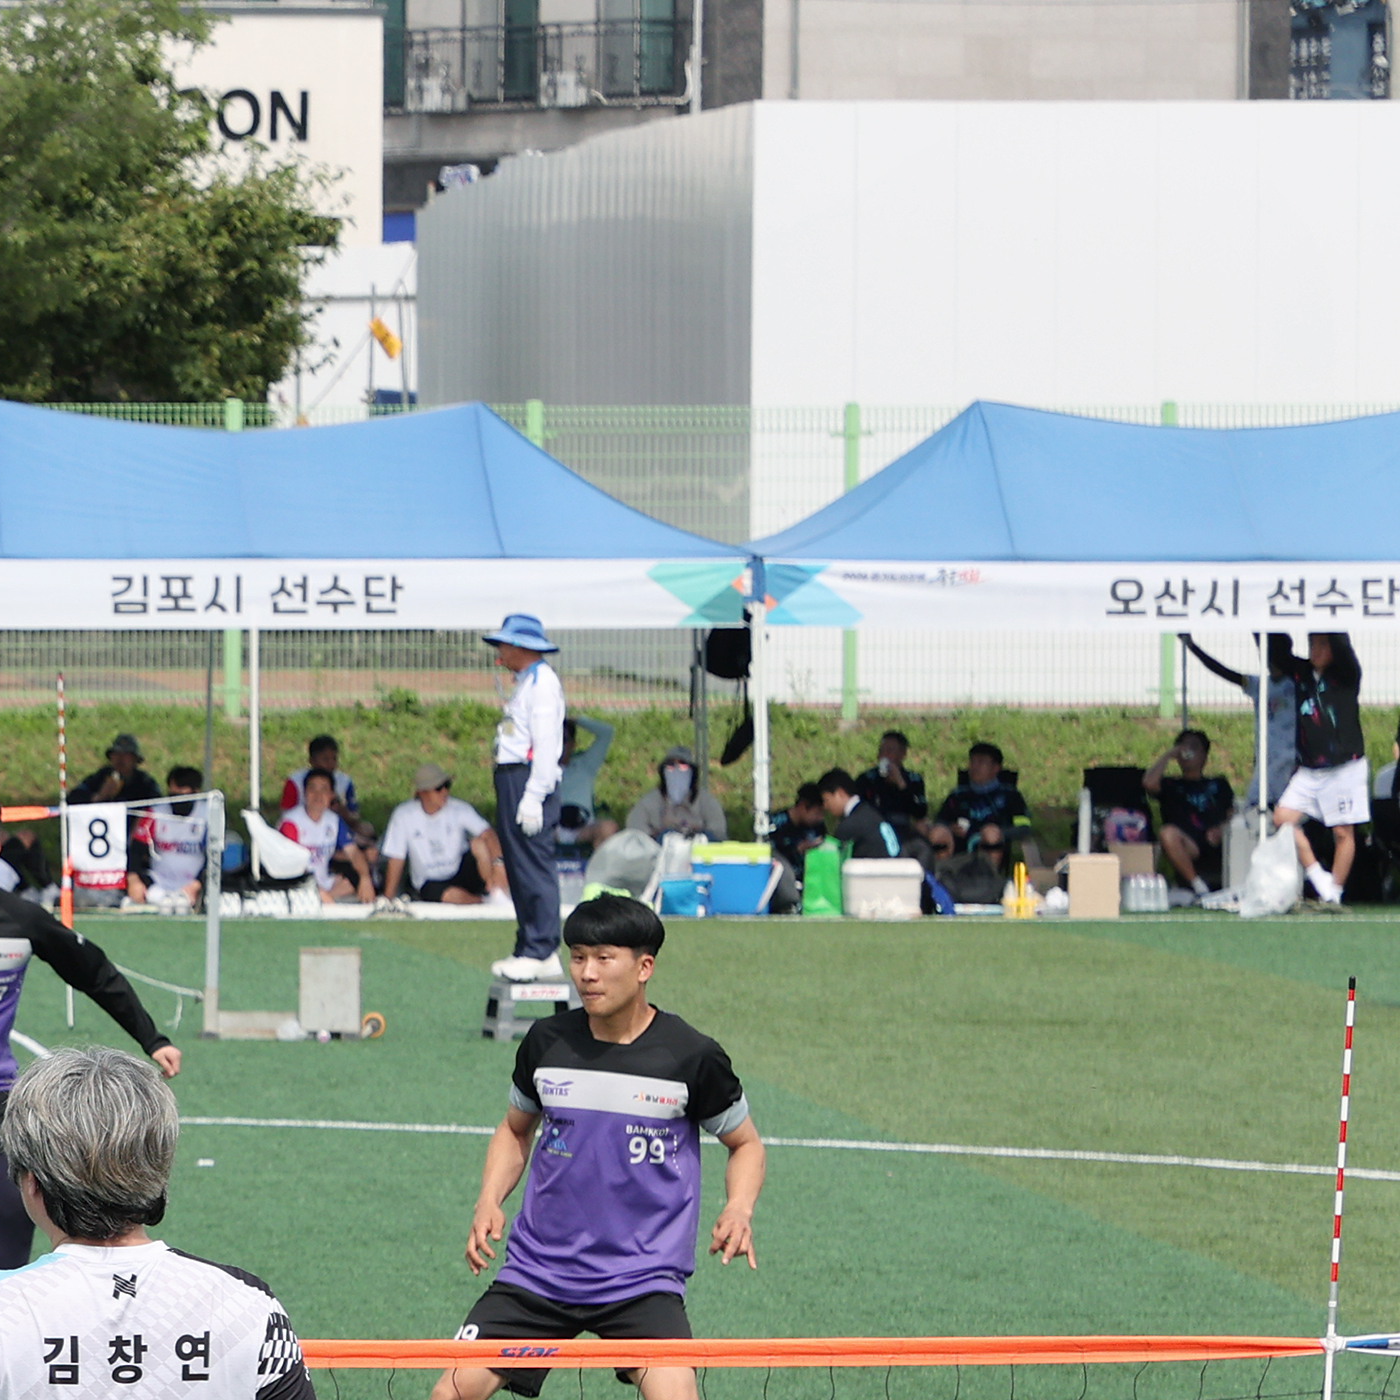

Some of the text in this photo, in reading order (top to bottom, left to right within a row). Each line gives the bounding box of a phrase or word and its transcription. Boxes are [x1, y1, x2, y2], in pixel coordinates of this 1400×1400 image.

[176, 87, 309, 143] ON
[111, 574, 404, 615] 김포시 선수단
[1105, 577, 1400, 618] 오산시 선수단
[88, 817, 111, 859] 8
[629, 1136, 665, 1164] 99
[499, 1346, 559, 1357] star
